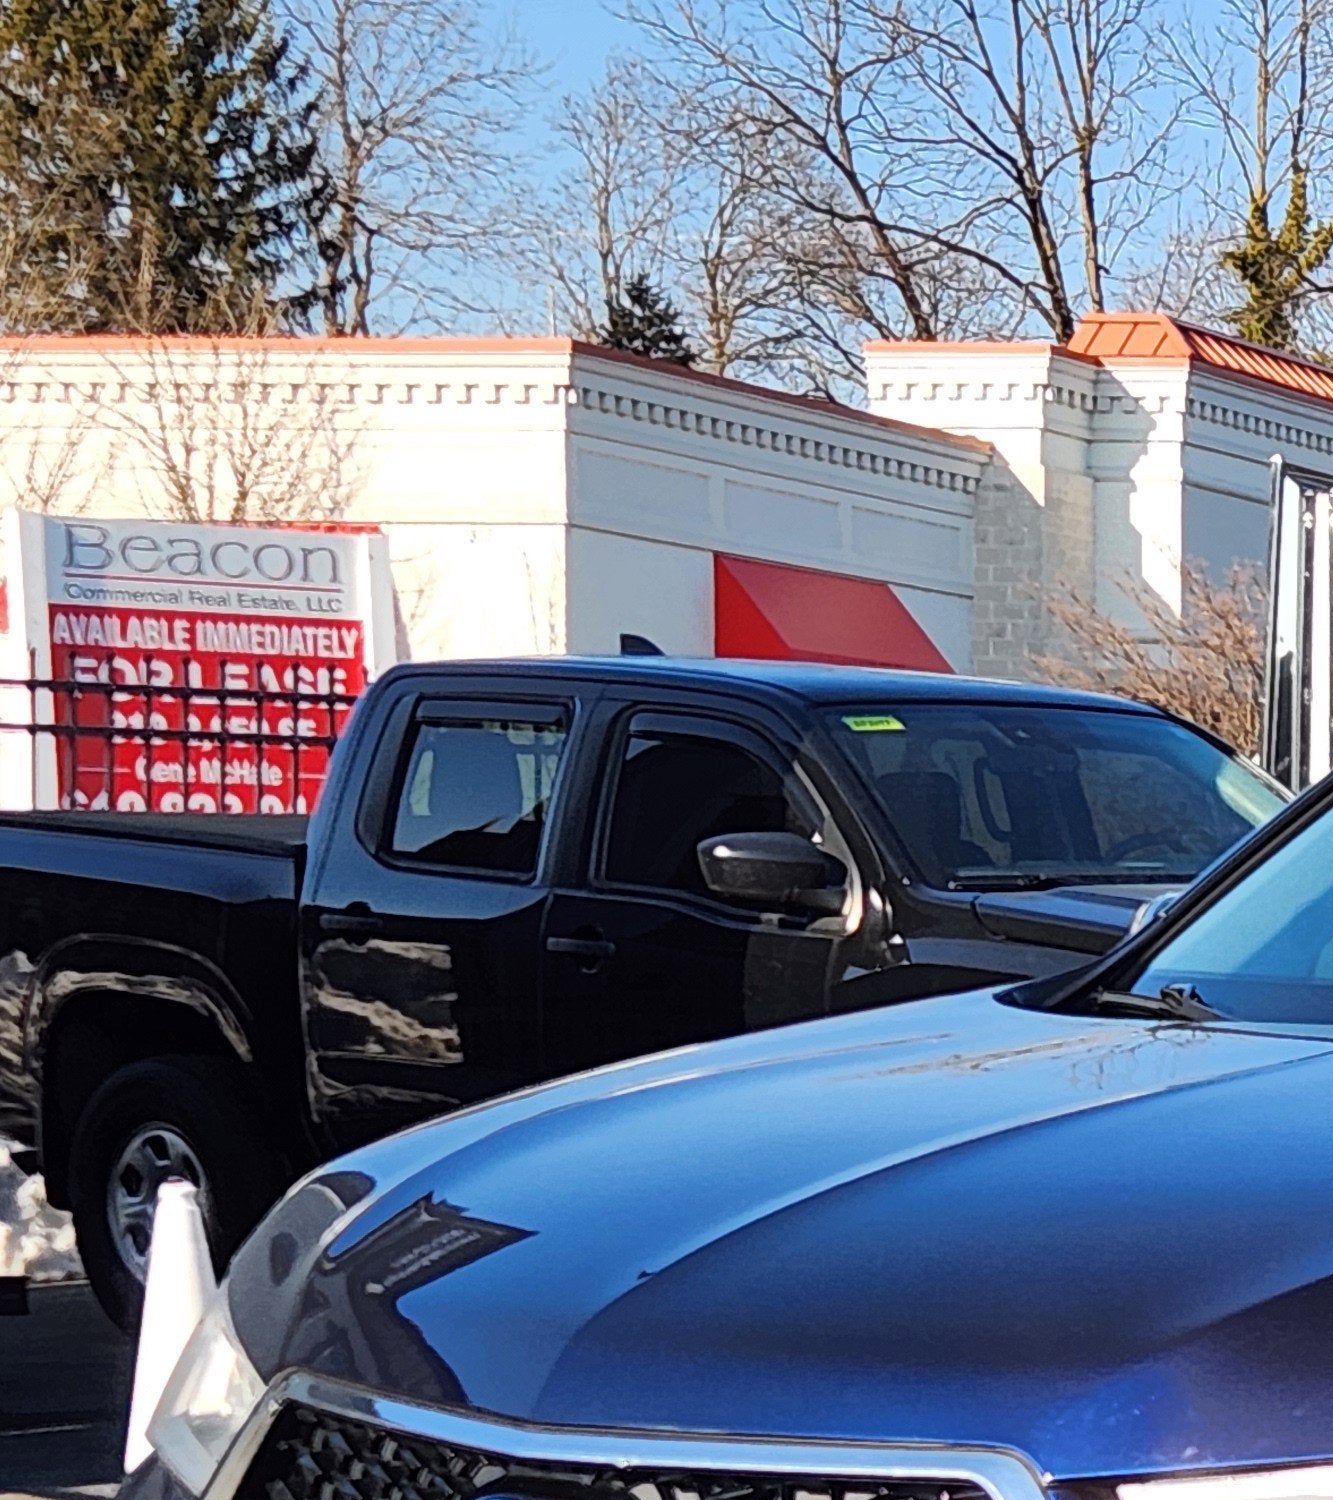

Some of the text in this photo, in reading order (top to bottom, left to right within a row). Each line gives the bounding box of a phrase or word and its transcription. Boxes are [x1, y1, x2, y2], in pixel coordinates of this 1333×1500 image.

[61, 523, 342, 583] Beacon
[64, 582, 184, 607] Commercial
[190, 590, 232, 608] Real
[306, 595, 344, 613] LLC
[54, 613, 358, 658] AVAILABLE IMMEDIATELY
